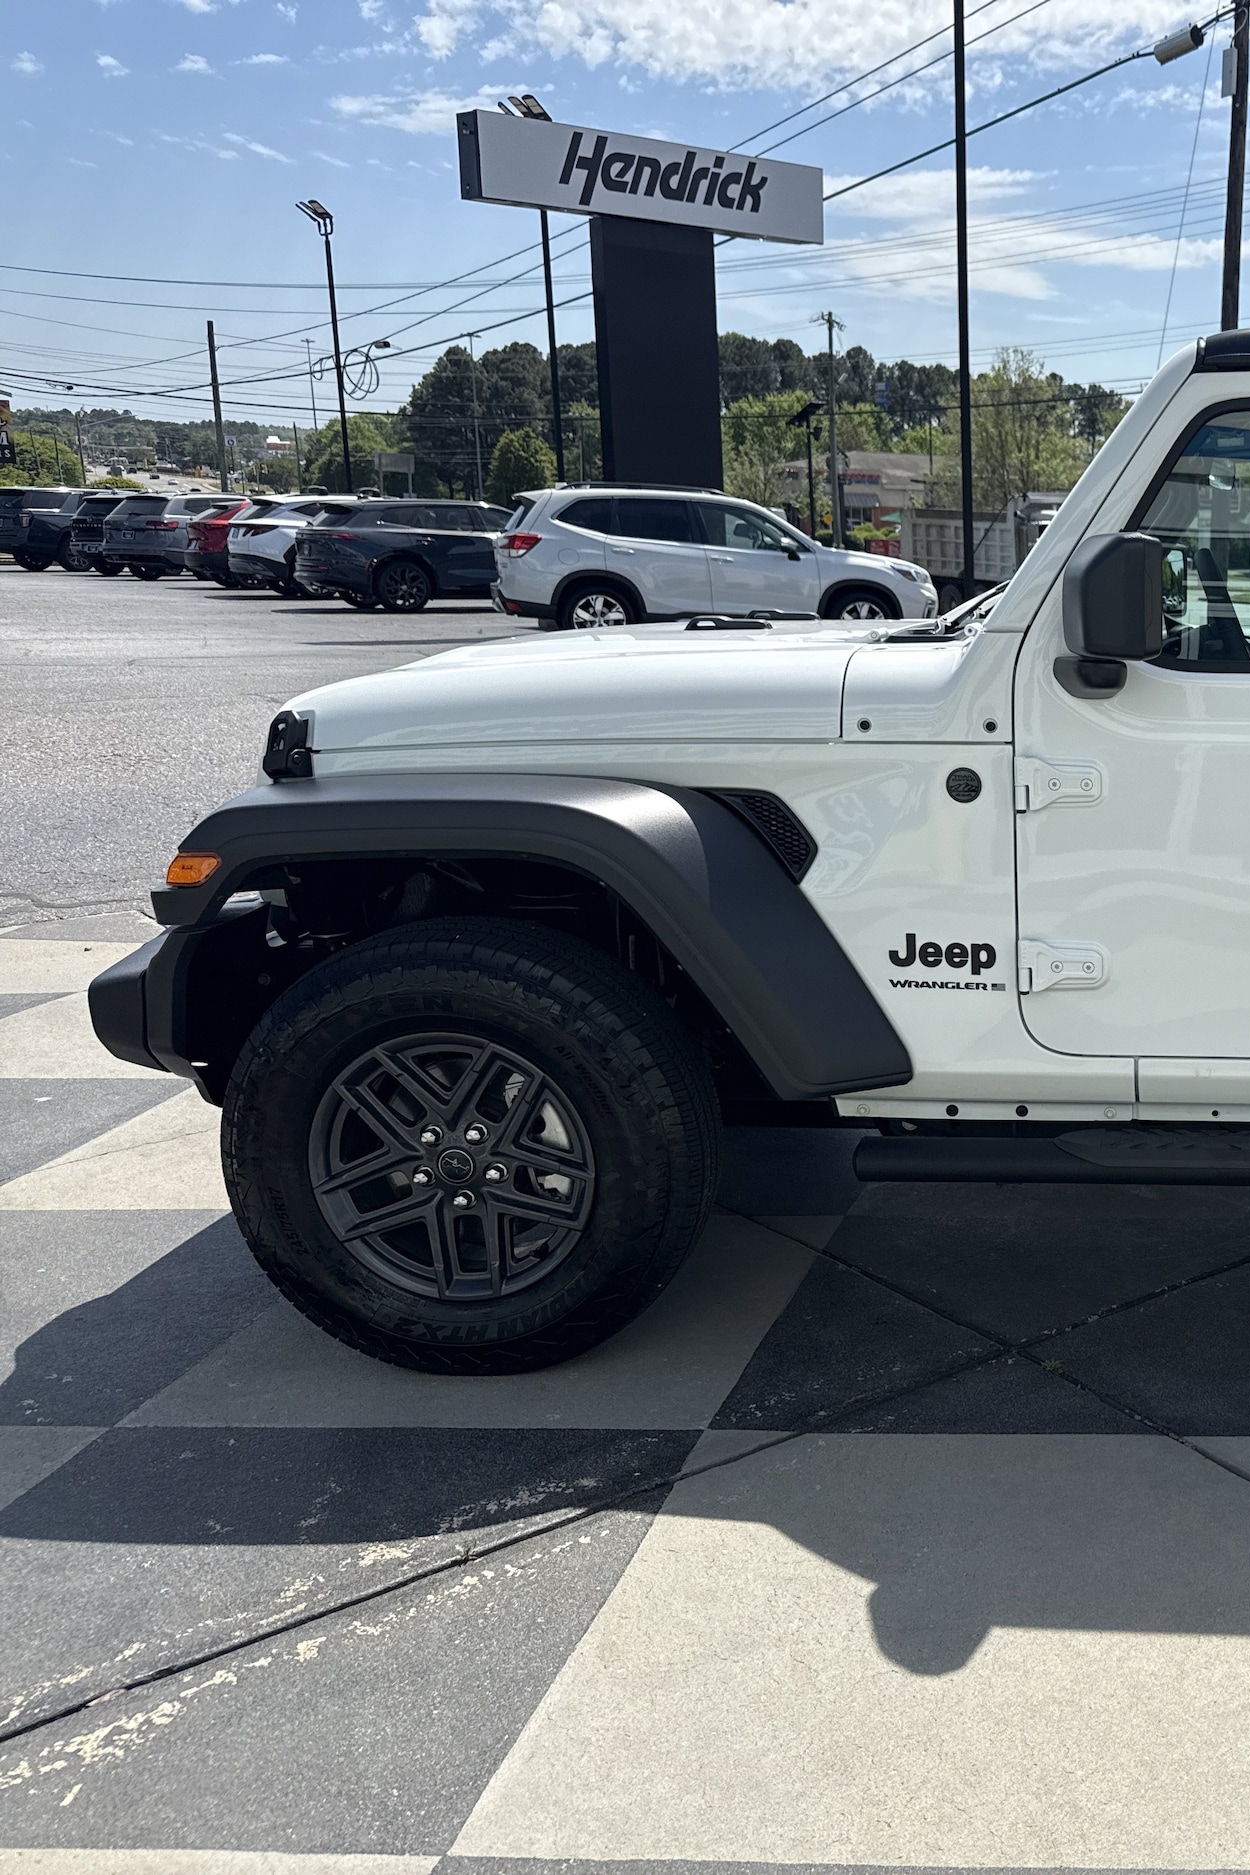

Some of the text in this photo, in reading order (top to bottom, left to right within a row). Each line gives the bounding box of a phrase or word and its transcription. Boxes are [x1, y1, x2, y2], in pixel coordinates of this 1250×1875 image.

[558, 131, 769, 213] Hendrick
[888, 932, 997, 976] Jeep
[888, 979, 989, 991] WRANGLER
[552, 1046, 614, 1117] All-Weather
[267, 1186, 310, 1256] 245/75R17
